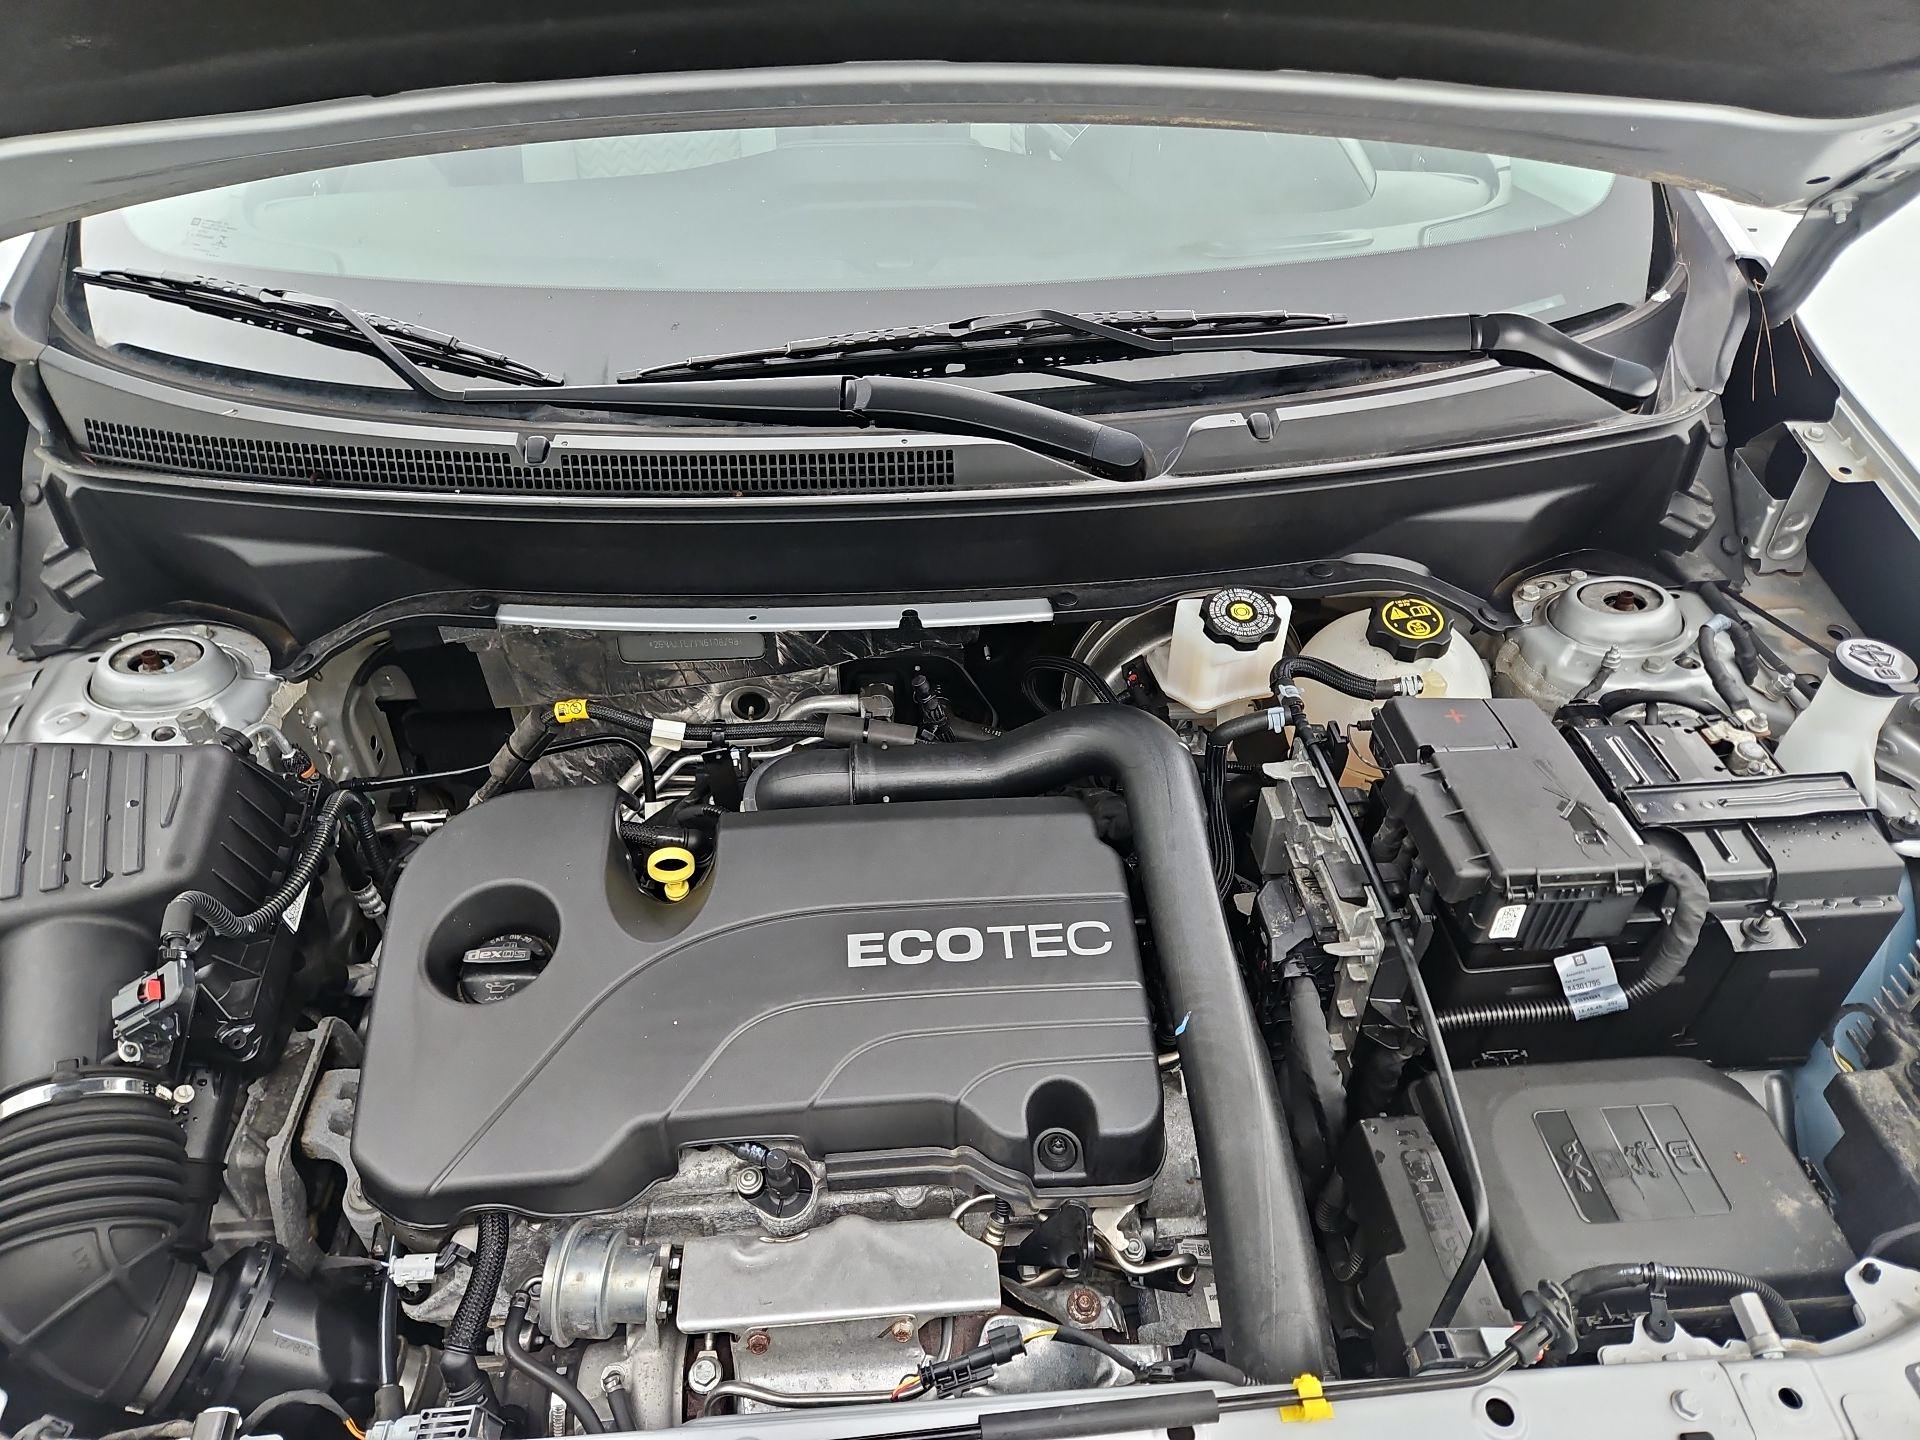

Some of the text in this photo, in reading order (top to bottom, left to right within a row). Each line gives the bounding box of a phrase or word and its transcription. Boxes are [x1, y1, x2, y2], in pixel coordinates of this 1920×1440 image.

[490, 935, 505, 945] SAE
[847, 920, 1112, 968] ECOTEC
[467, 949, 526, 960] dexos
